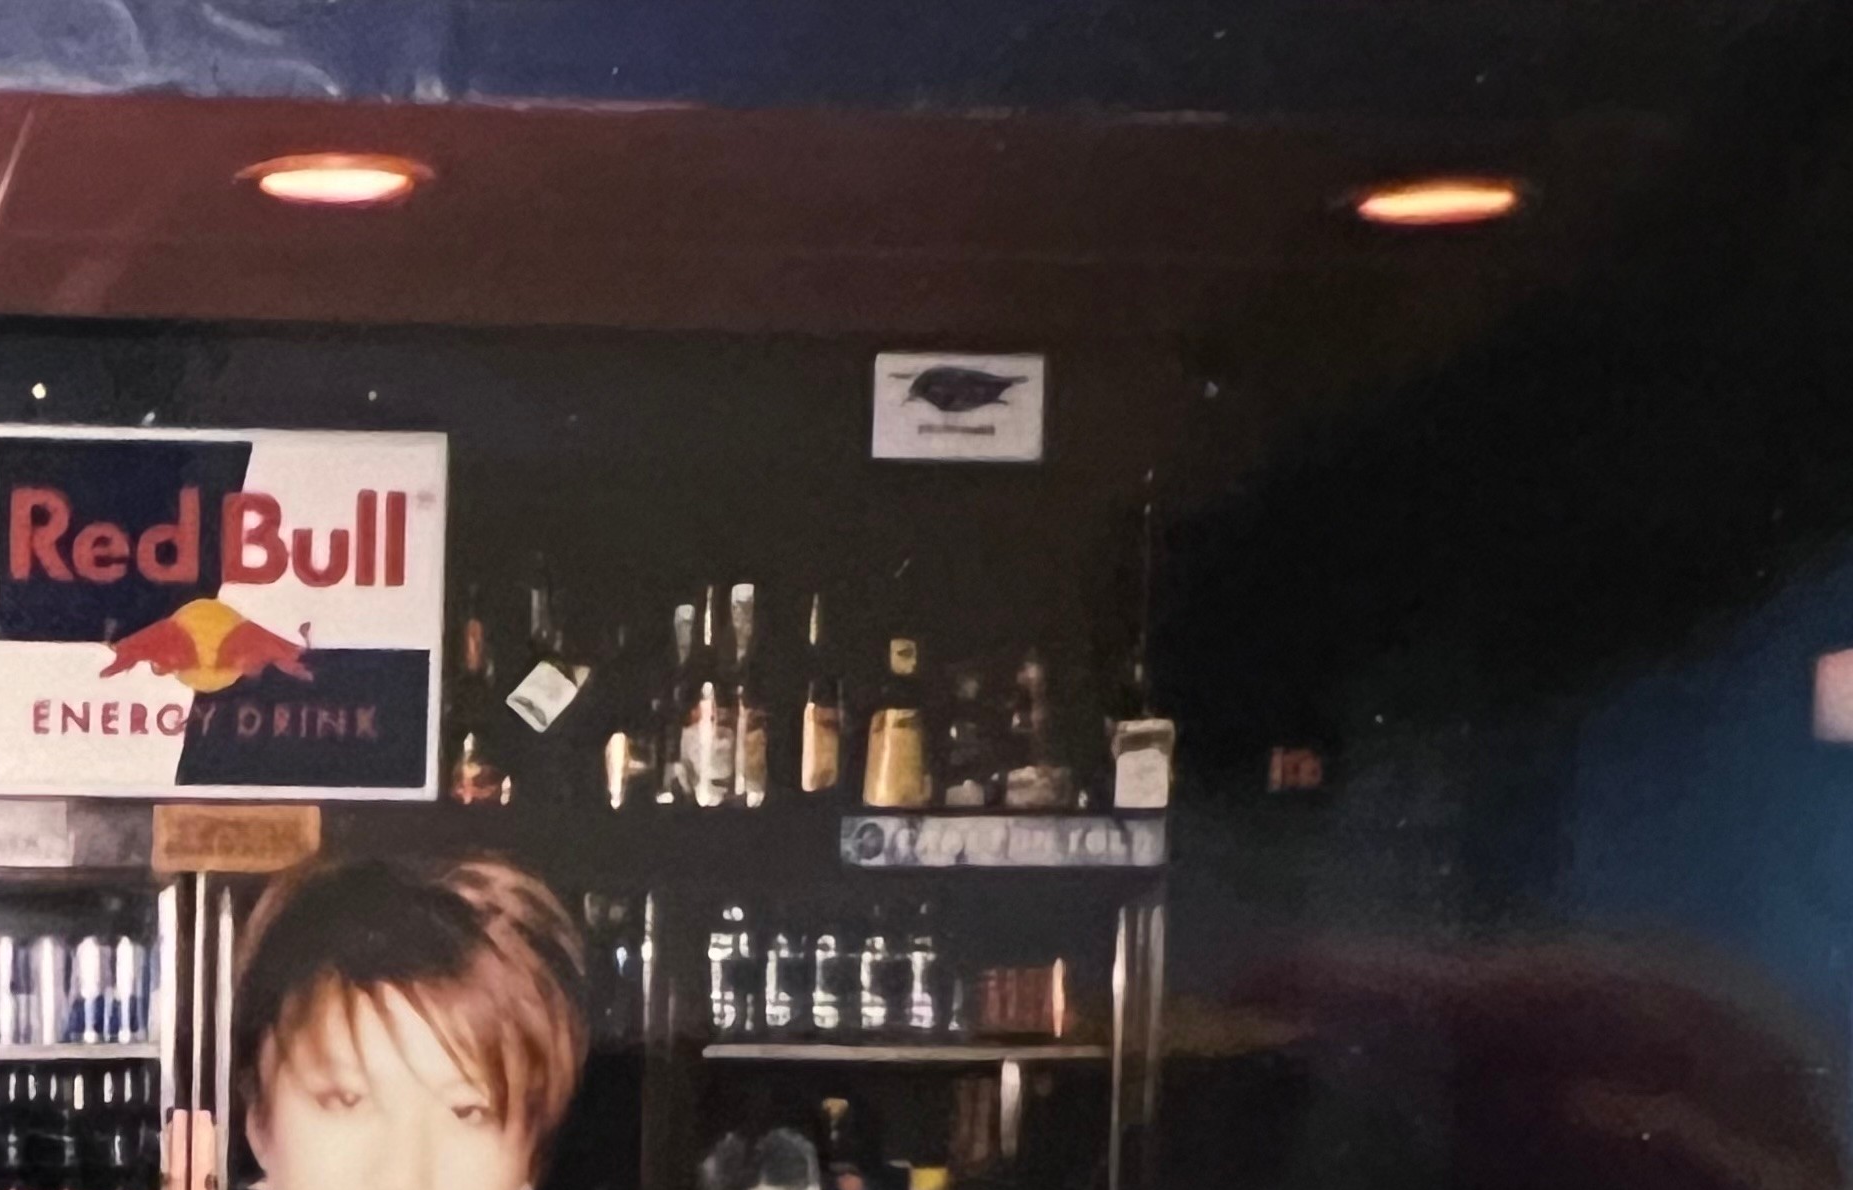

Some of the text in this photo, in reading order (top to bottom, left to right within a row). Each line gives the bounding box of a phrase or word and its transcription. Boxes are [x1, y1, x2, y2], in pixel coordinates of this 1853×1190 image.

[10, 486, 406, 588] Red Bull
[33, 700, 378, 741] ENERGY DRINK
